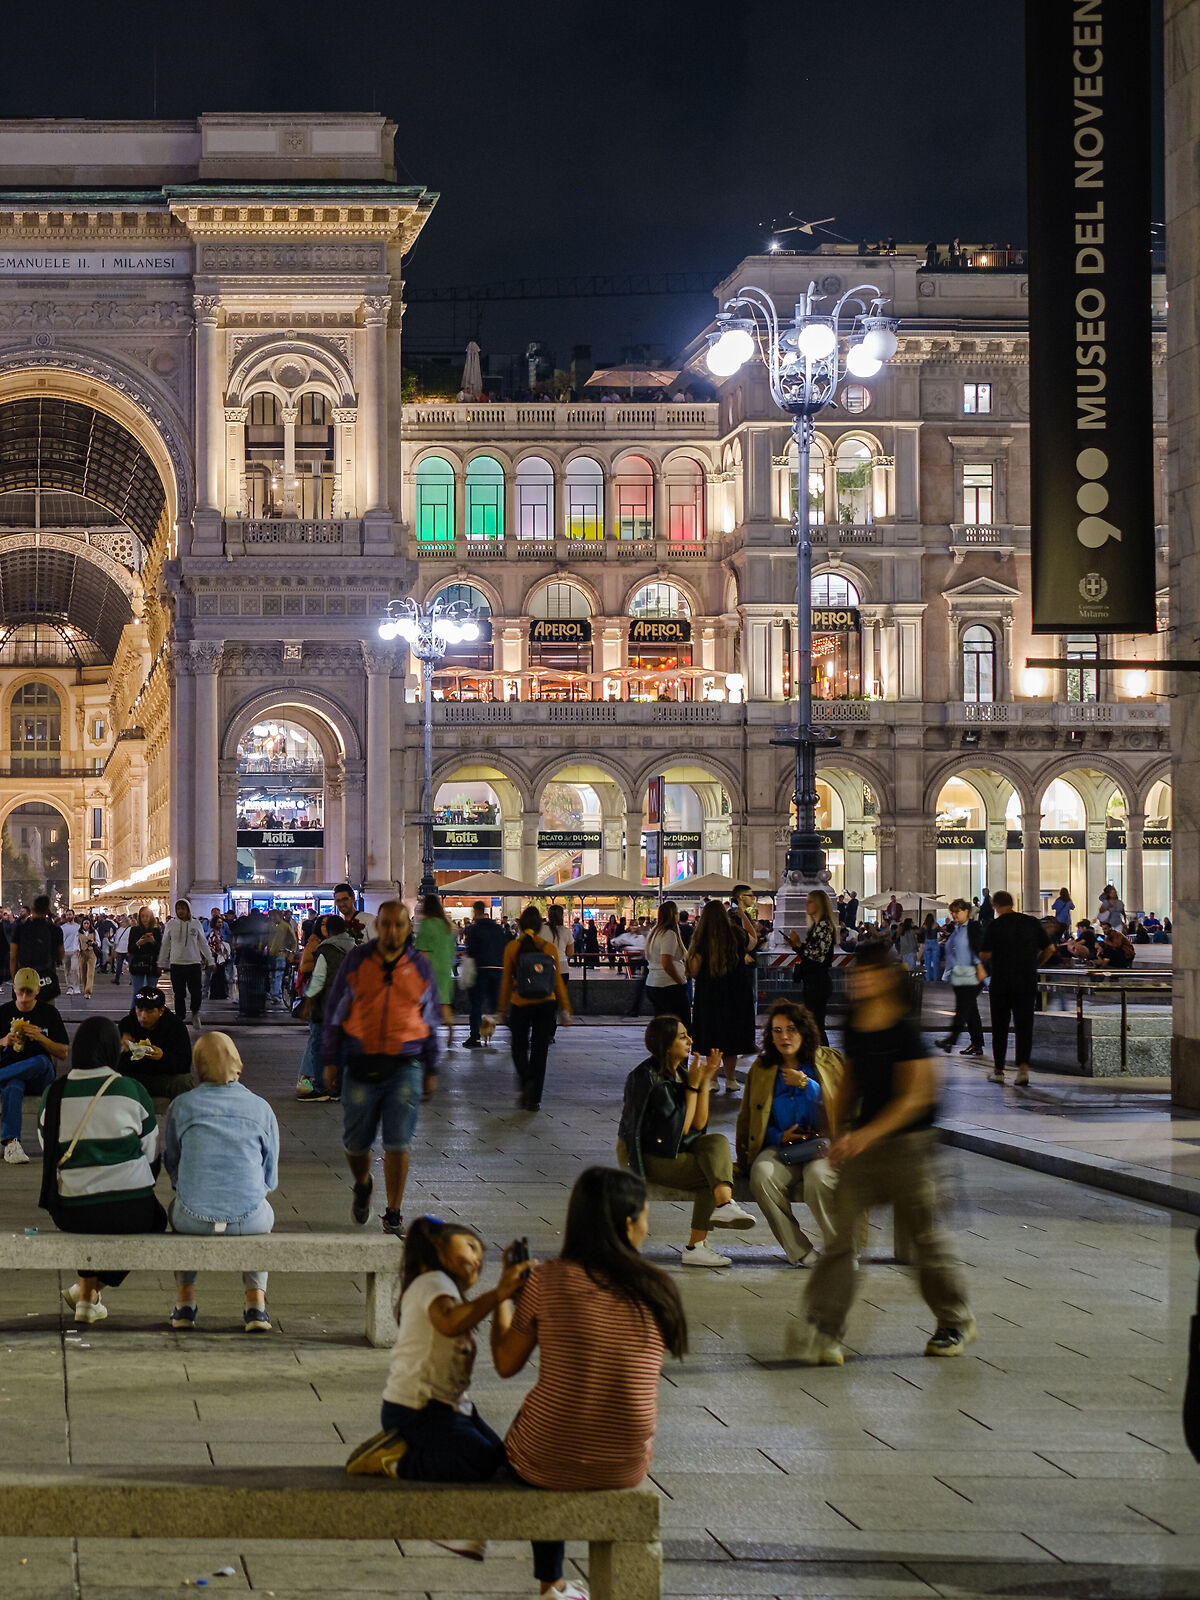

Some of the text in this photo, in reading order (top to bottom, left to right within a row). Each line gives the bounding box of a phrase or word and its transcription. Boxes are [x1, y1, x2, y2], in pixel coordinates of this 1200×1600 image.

[1074, 201, 1105, 274] DEL
[113, 258, 175, 268] MILANESI
[1075, 288, 1107, 430] MUSEO
[535, 621, 584, 636] APEROL
[634, 621, 683, 636] APEROL
[262, 832, 295, 843] Motta
[445, 832, 479, 843] Motta
